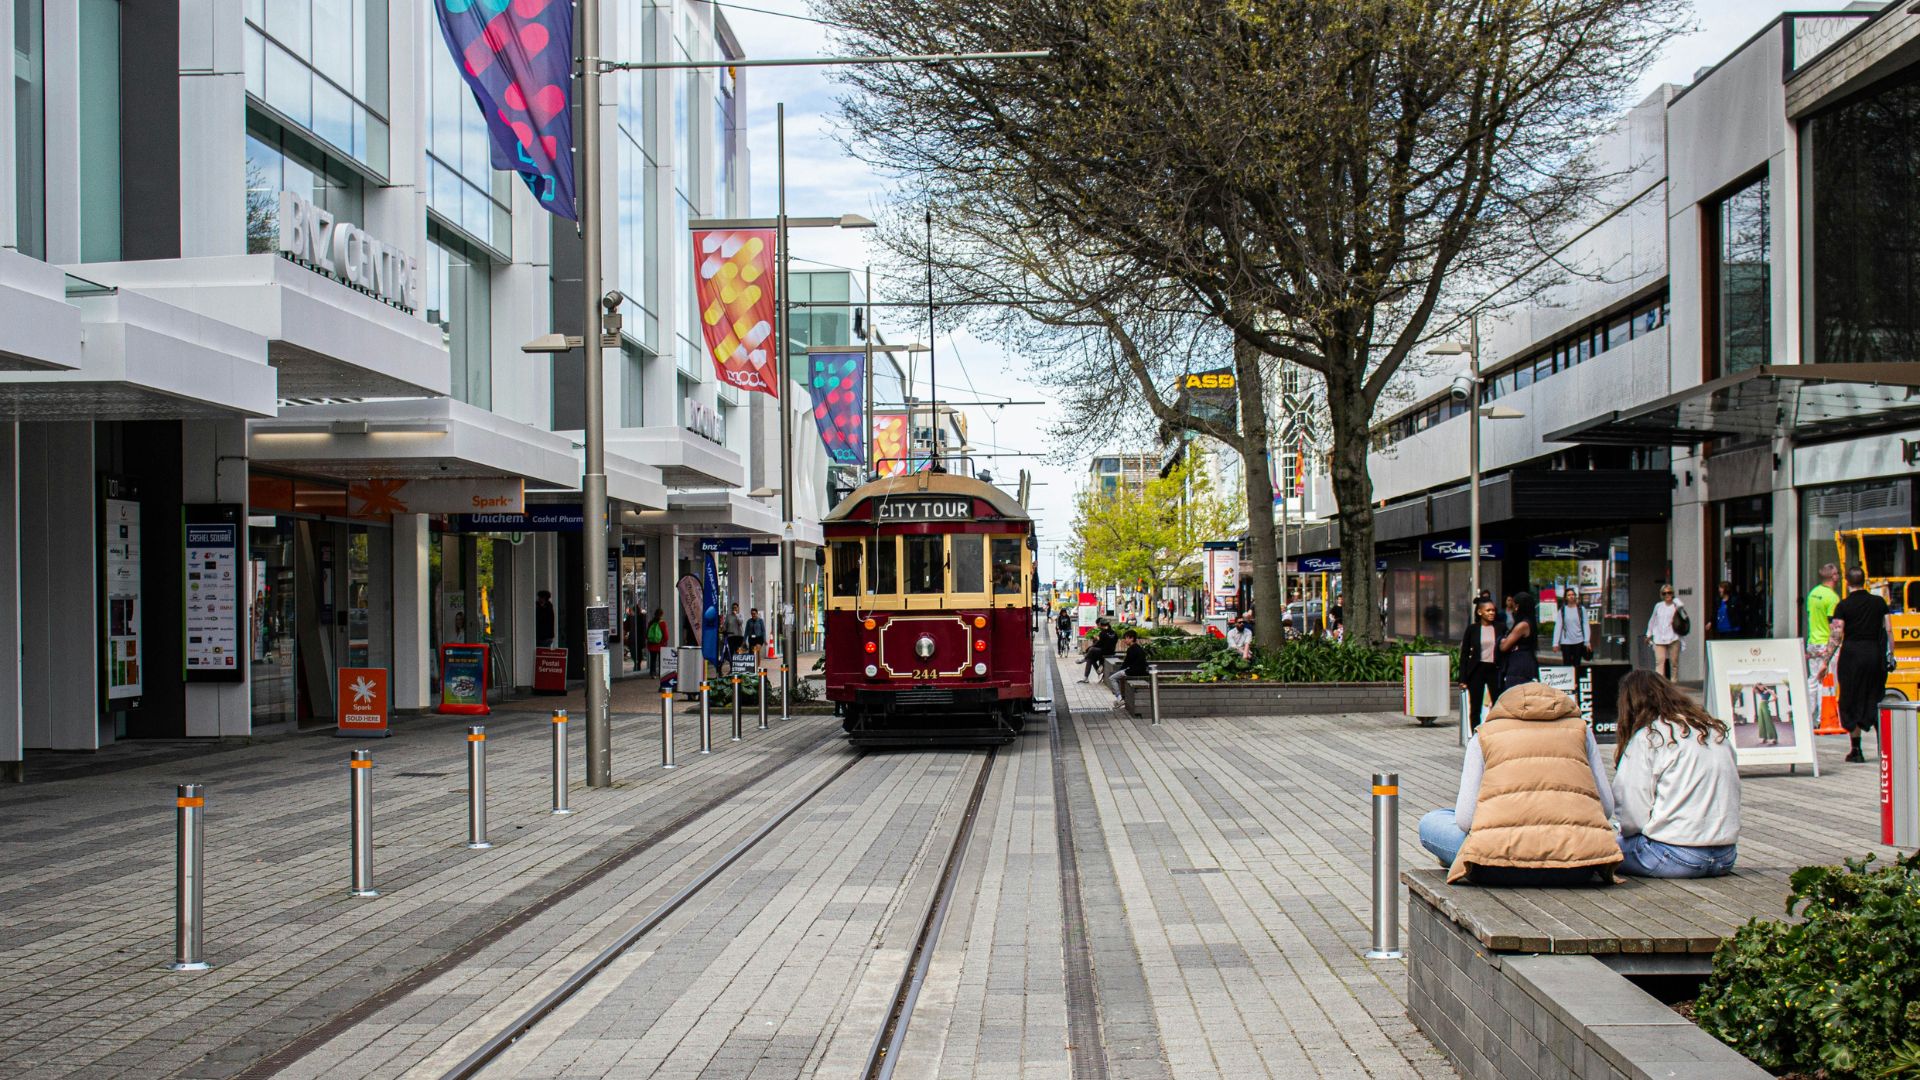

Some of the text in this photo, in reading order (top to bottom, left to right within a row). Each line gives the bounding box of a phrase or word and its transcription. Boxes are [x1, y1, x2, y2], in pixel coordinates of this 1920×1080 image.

[279, 191, 417, 311] BNZ CENTRE
[1186, 374, 1235, 389] ASB
[472, 496, 507, 508] Spark
[879, 502, 969, 518] CITY TOUR
[472, 513, 584, 524] Unichem Cashel Pharm
[189, 534, 232, 542] CASHEL SQUARE
[912, 669, 938, 679] 244
[1596, 723, 1618, 732] OPE
[1880, 750, 1890, 804] Litter
